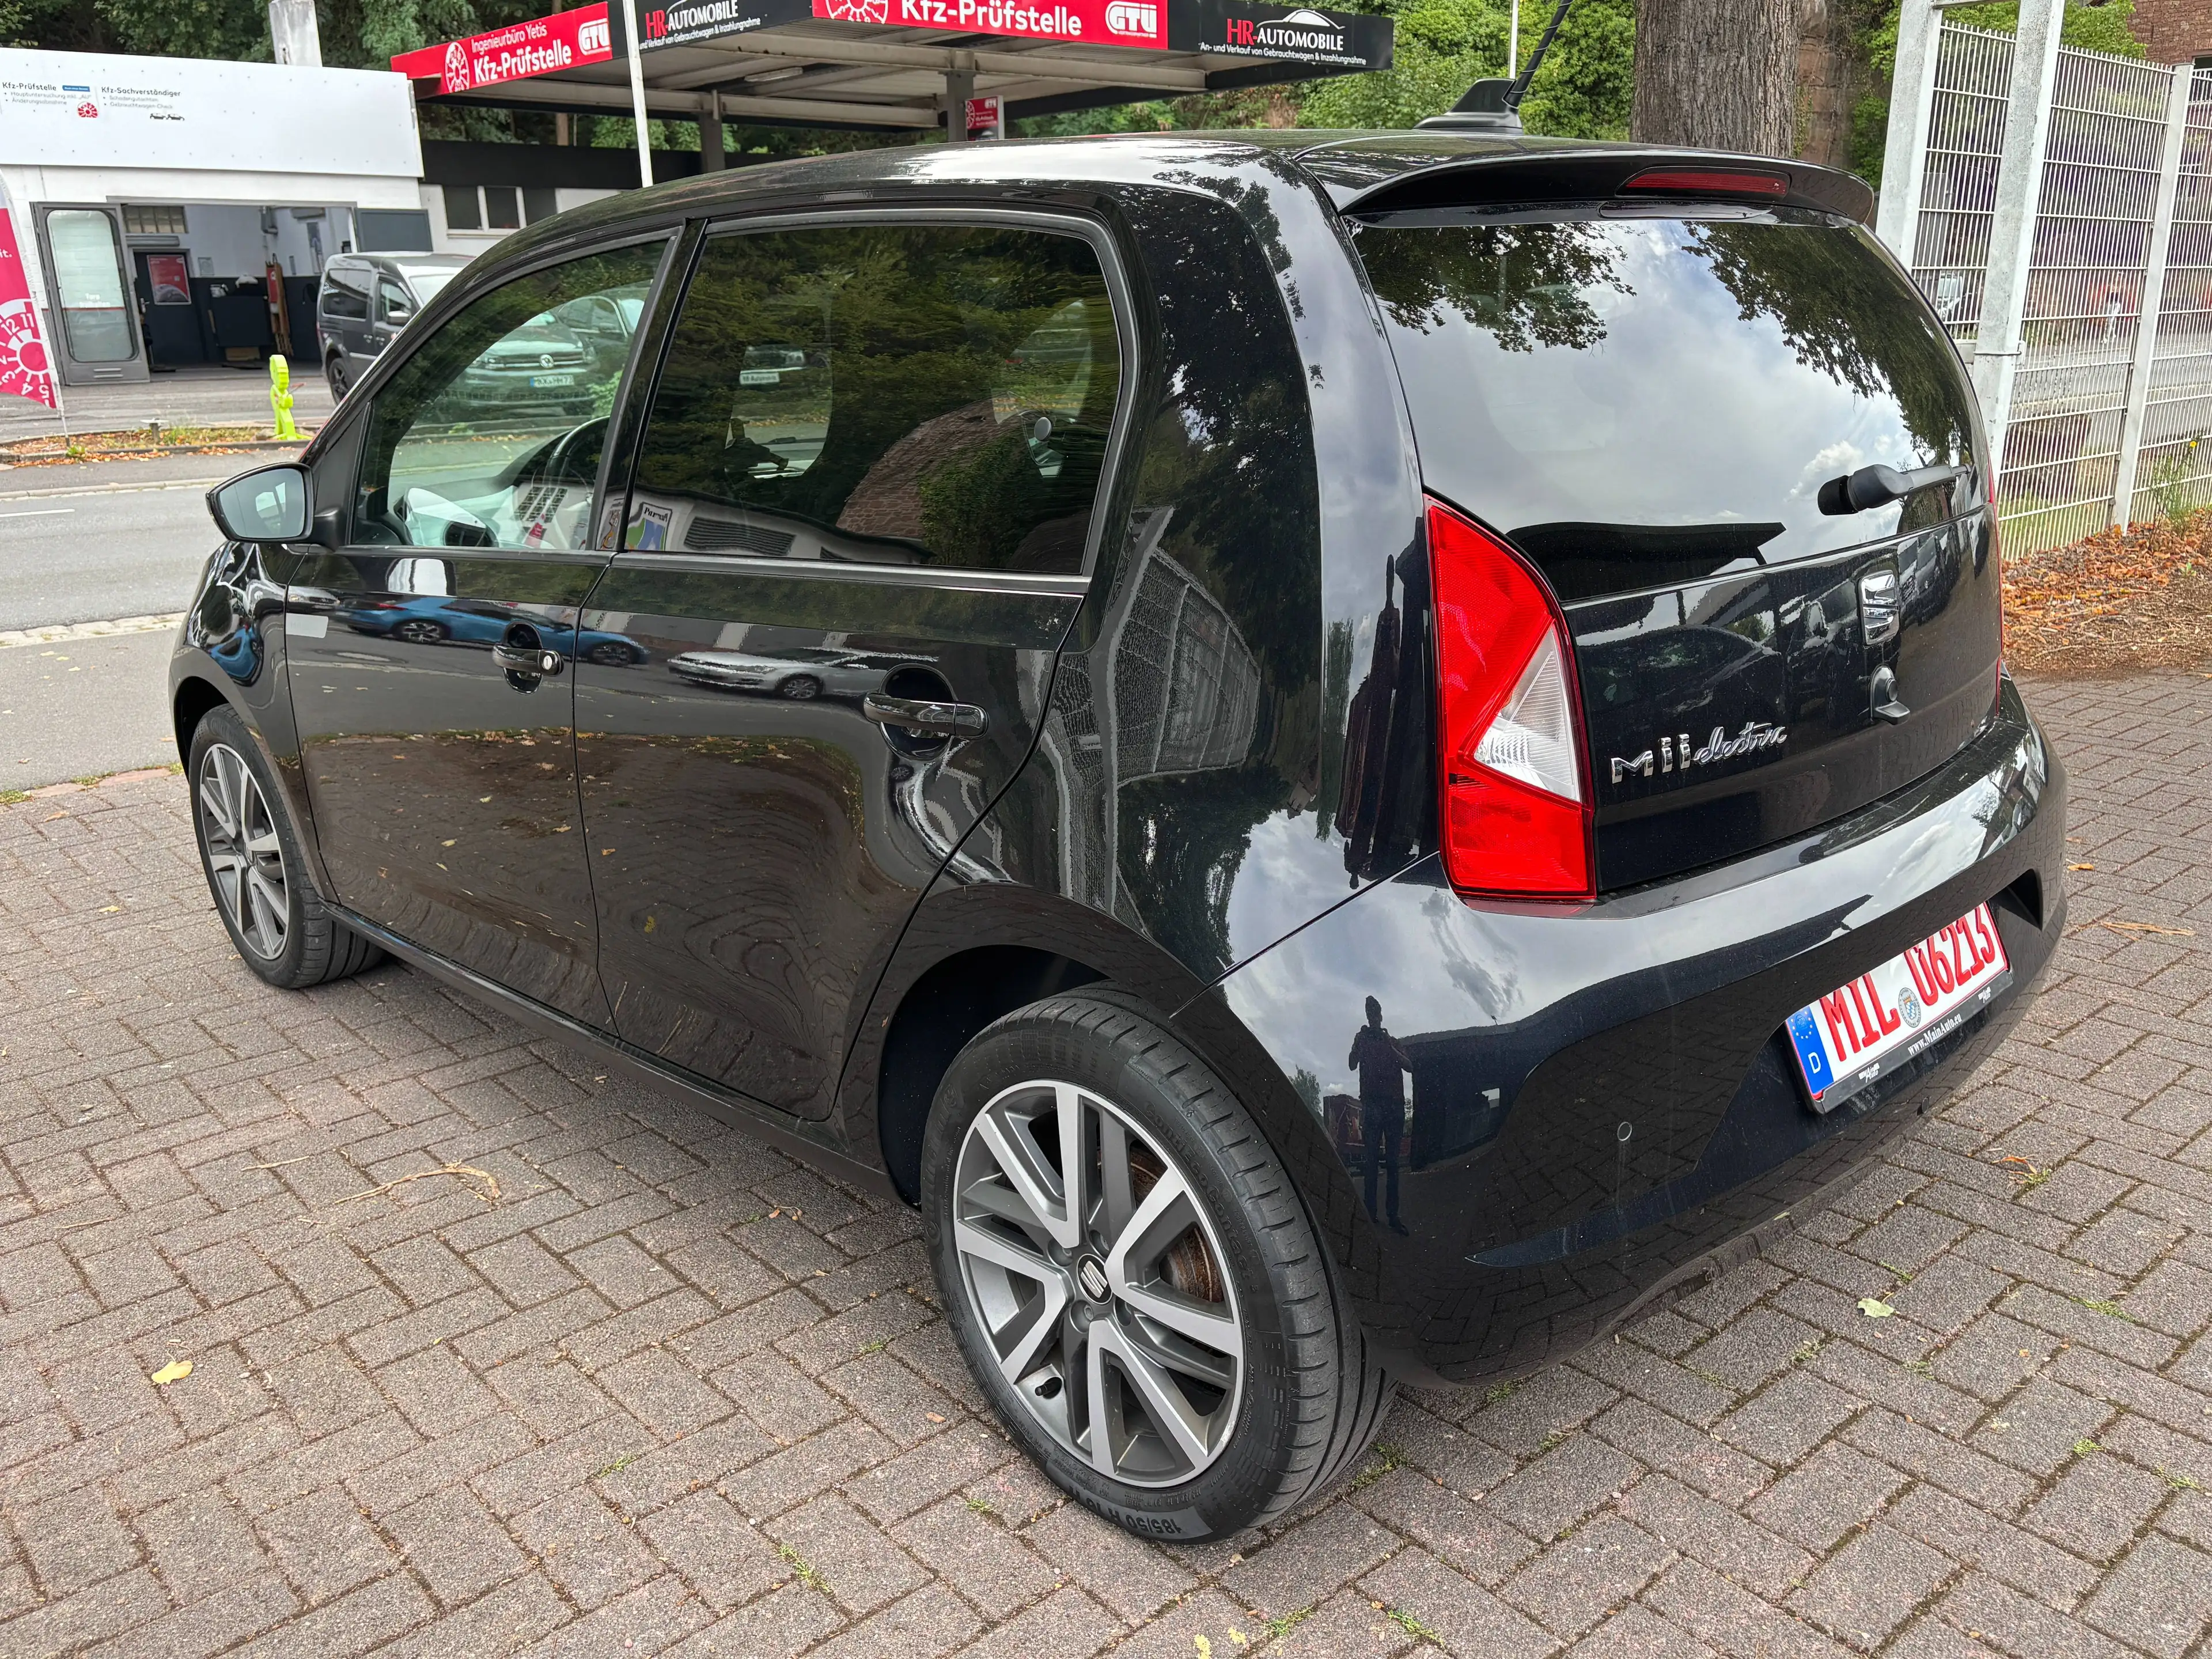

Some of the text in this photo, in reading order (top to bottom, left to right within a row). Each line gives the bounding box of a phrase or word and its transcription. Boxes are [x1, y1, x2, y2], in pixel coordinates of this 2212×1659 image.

[646, 0, 738, 38] HR-AUTOMOBILE
[902, 0, 1081, 35] Kfz-Prüfstelle
[471, 22, 547, 55] Ingenieurbüro Yetis
[1227, 18, 1343, 51] HR-AUTOMOBILE
[474, 39, 572, 84] Kfz-Prüfstelle
[1200, 41, 1212, 51] An-
[1213, 44, 1226, 52] und
[1226, 44, 1251, 54] Verkauf
[1315, 52, 1320, 60] &
[1320, 52, 1366, 65] Inzahlungnahme
[2, 82, 56, 91] Kfz-Prüfstelle
[101, 86, 181, 97] Kfz-Sachverständiger
[1691, 721, 1787, 766] electric
[1819, 903, 1995, 1062] MIL 06213
[1908, 1013, 1963, 1056] www.MainAuto.eu
[1808, 1052, 1821, 1074] D
[1126, 1514, 1183, 1535] 185/50
